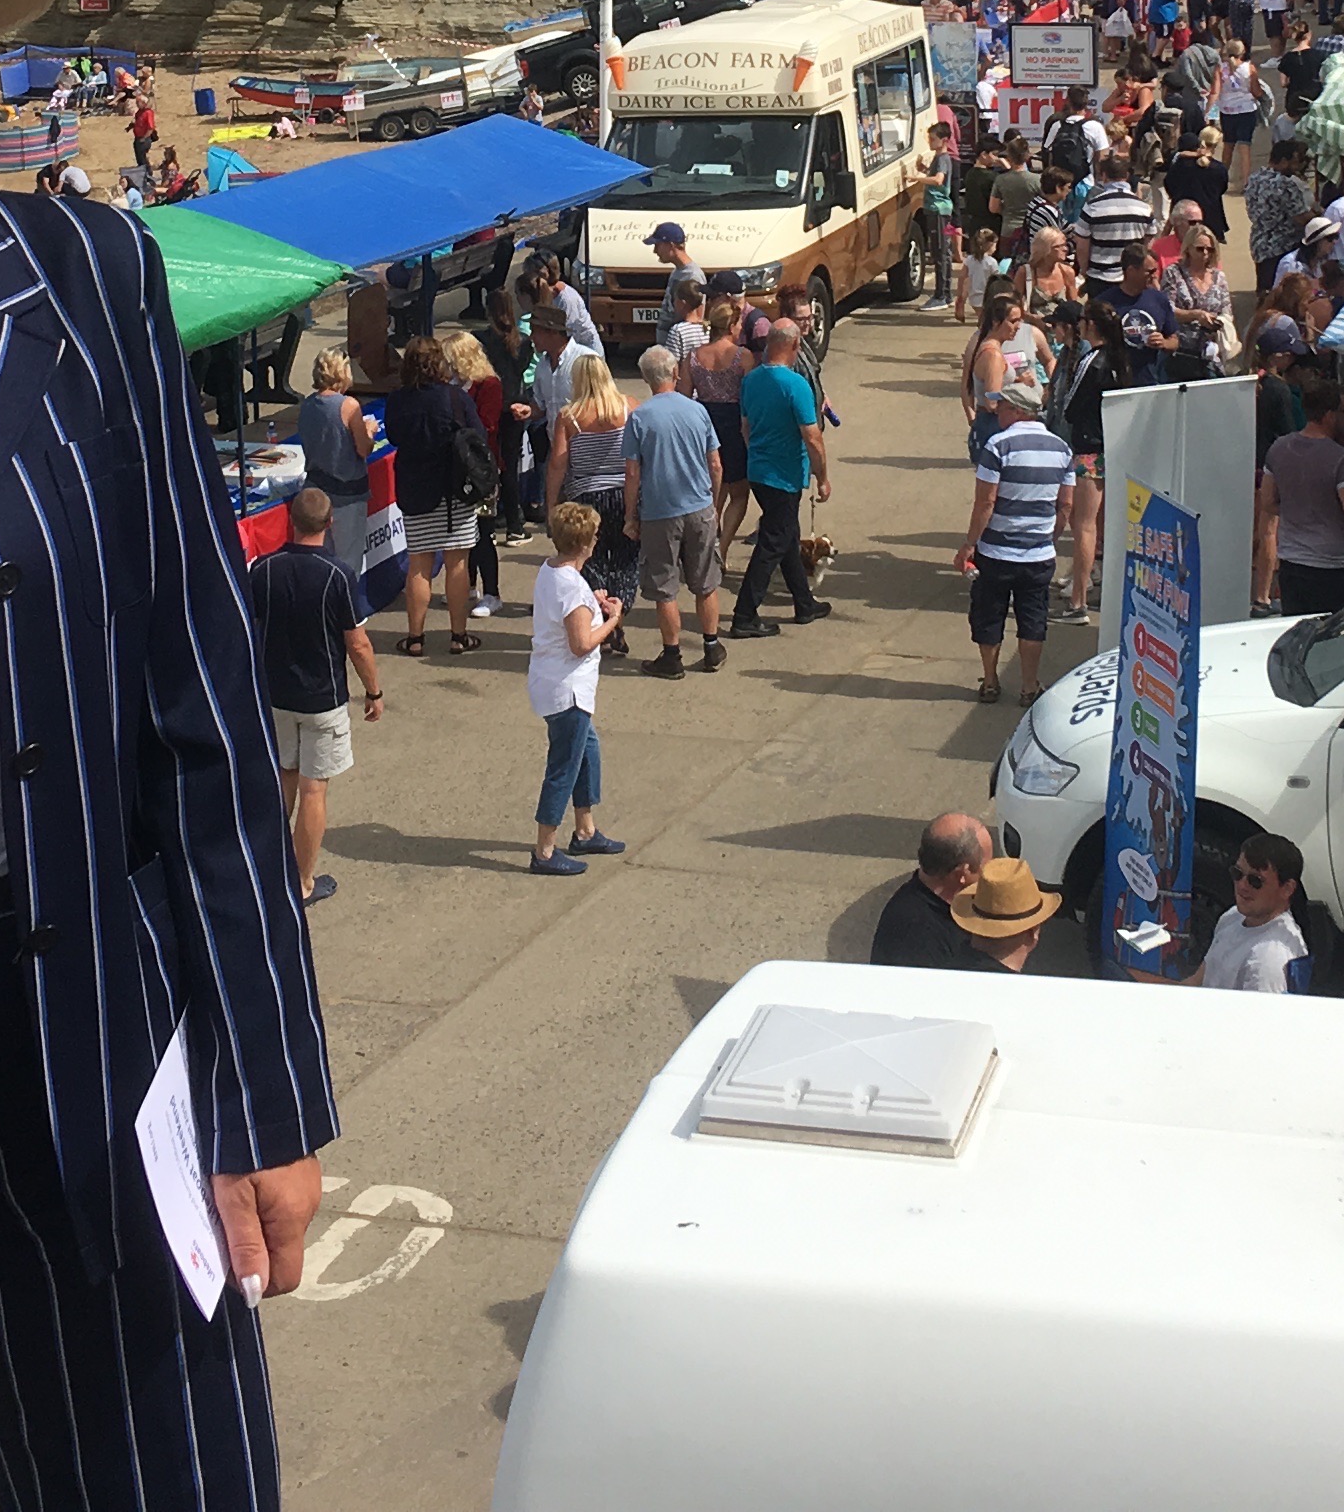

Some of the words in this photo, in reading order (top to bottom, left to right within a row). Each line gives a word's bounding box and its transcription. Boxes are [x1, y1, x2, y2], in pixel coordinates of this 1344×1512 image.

[857, 23, 891, 55] BEACON
[891, 11, 915, 39] FARM
[627, 51, 718, 73] BEACON
[731, 51, 799, 70] FARM
[1025, 56, 1038, 64] NO
[1040, 56, 1080, 64] PARKING
[653, 75, 747, 92] Traditional
[617, 94, 674, 110] DAIRY
[682, 94, 717, 110] ICE
[725, 93, 806, 109] CREAM
[1009, 90, 1069, 125] rrt
[694, 220, 720, 230] the
[726, 224, 764, 236] cow,
[593, 234, 618, 243] not
[1126, 521, 1144, 555] BE
[1145, 526, 1174, 565] SAFE
[1138, 631, 1144, 649] 1
[1136, 669, 1143, 689] 2
[1135, 709, 1141, 728] 3
[1133, 749, 1139, 768] 4
[169, 1094, 191, 1168] Weekend
